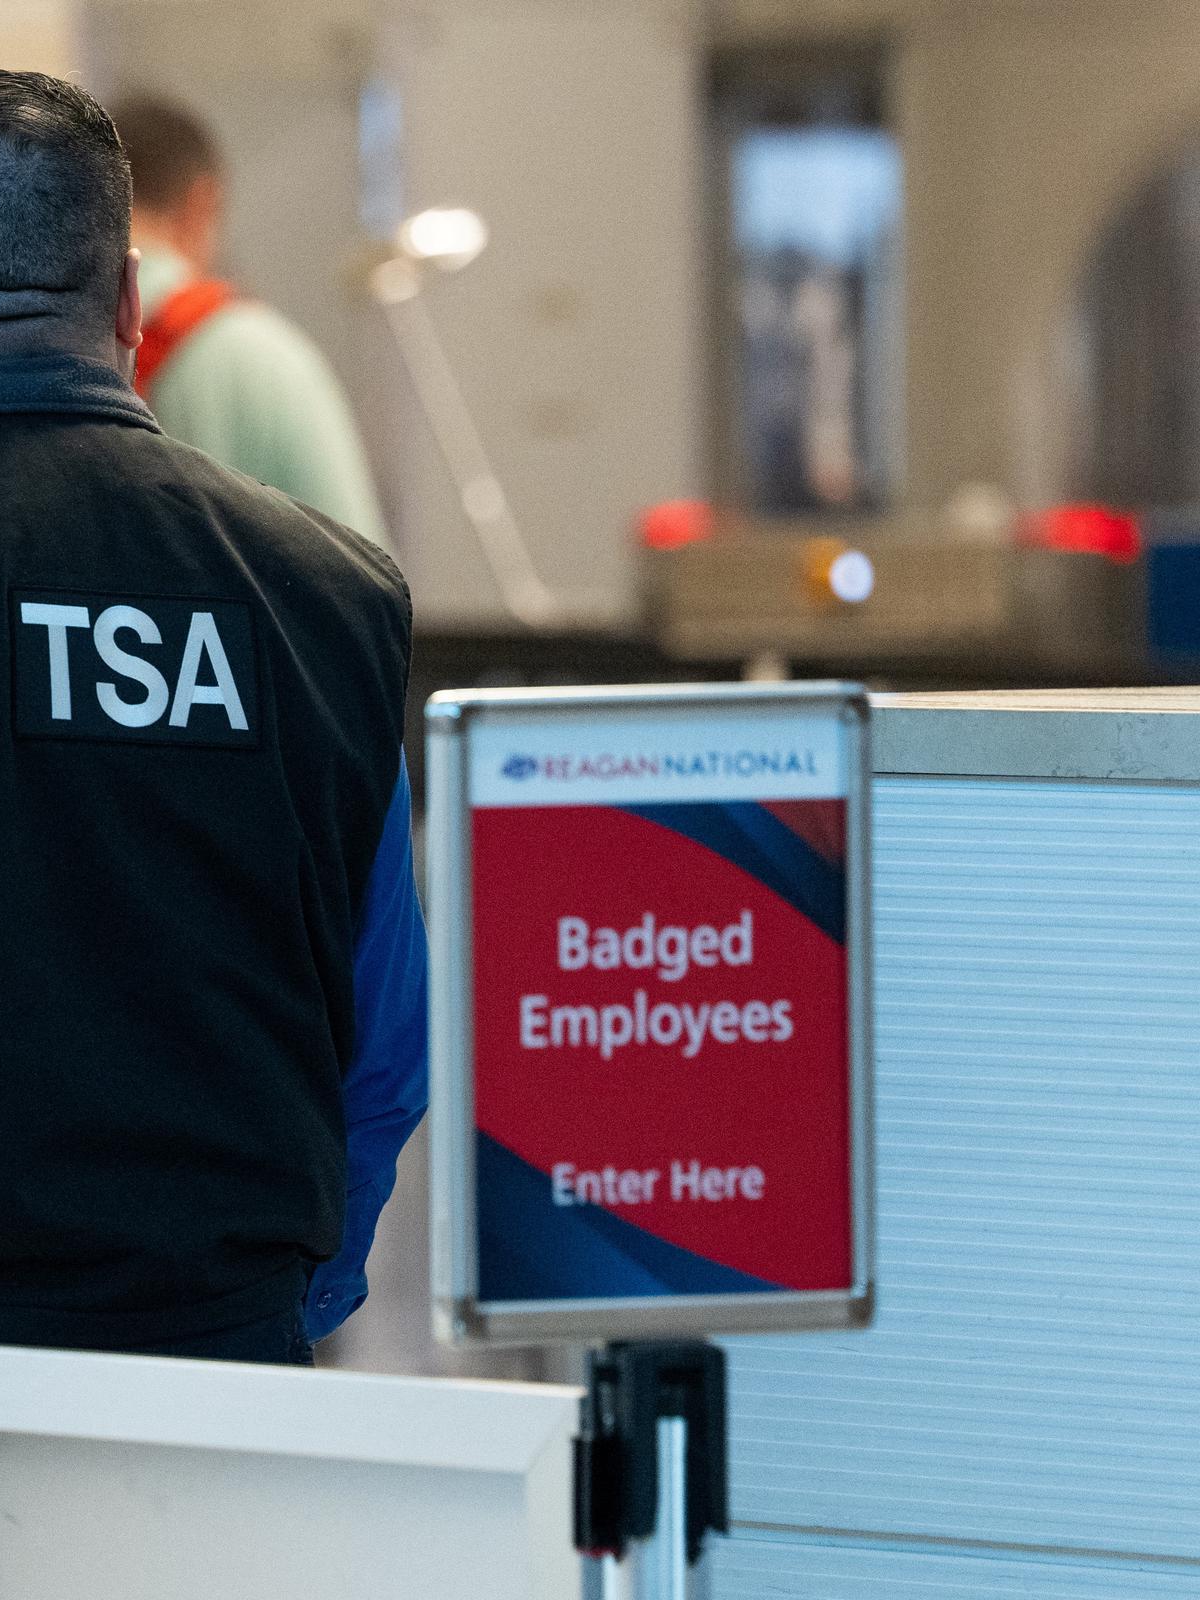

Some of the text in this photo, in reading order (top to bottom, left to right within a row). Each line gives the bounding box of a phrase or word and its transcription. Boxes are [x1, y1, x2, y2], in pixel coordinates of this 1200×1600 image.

[20, 602, 249, 730] TSA
[557, 908, 753, 983] Badged
[519, 988, 794, 1061] Employees
[552, 1158, 766, 1207] Enter Here
